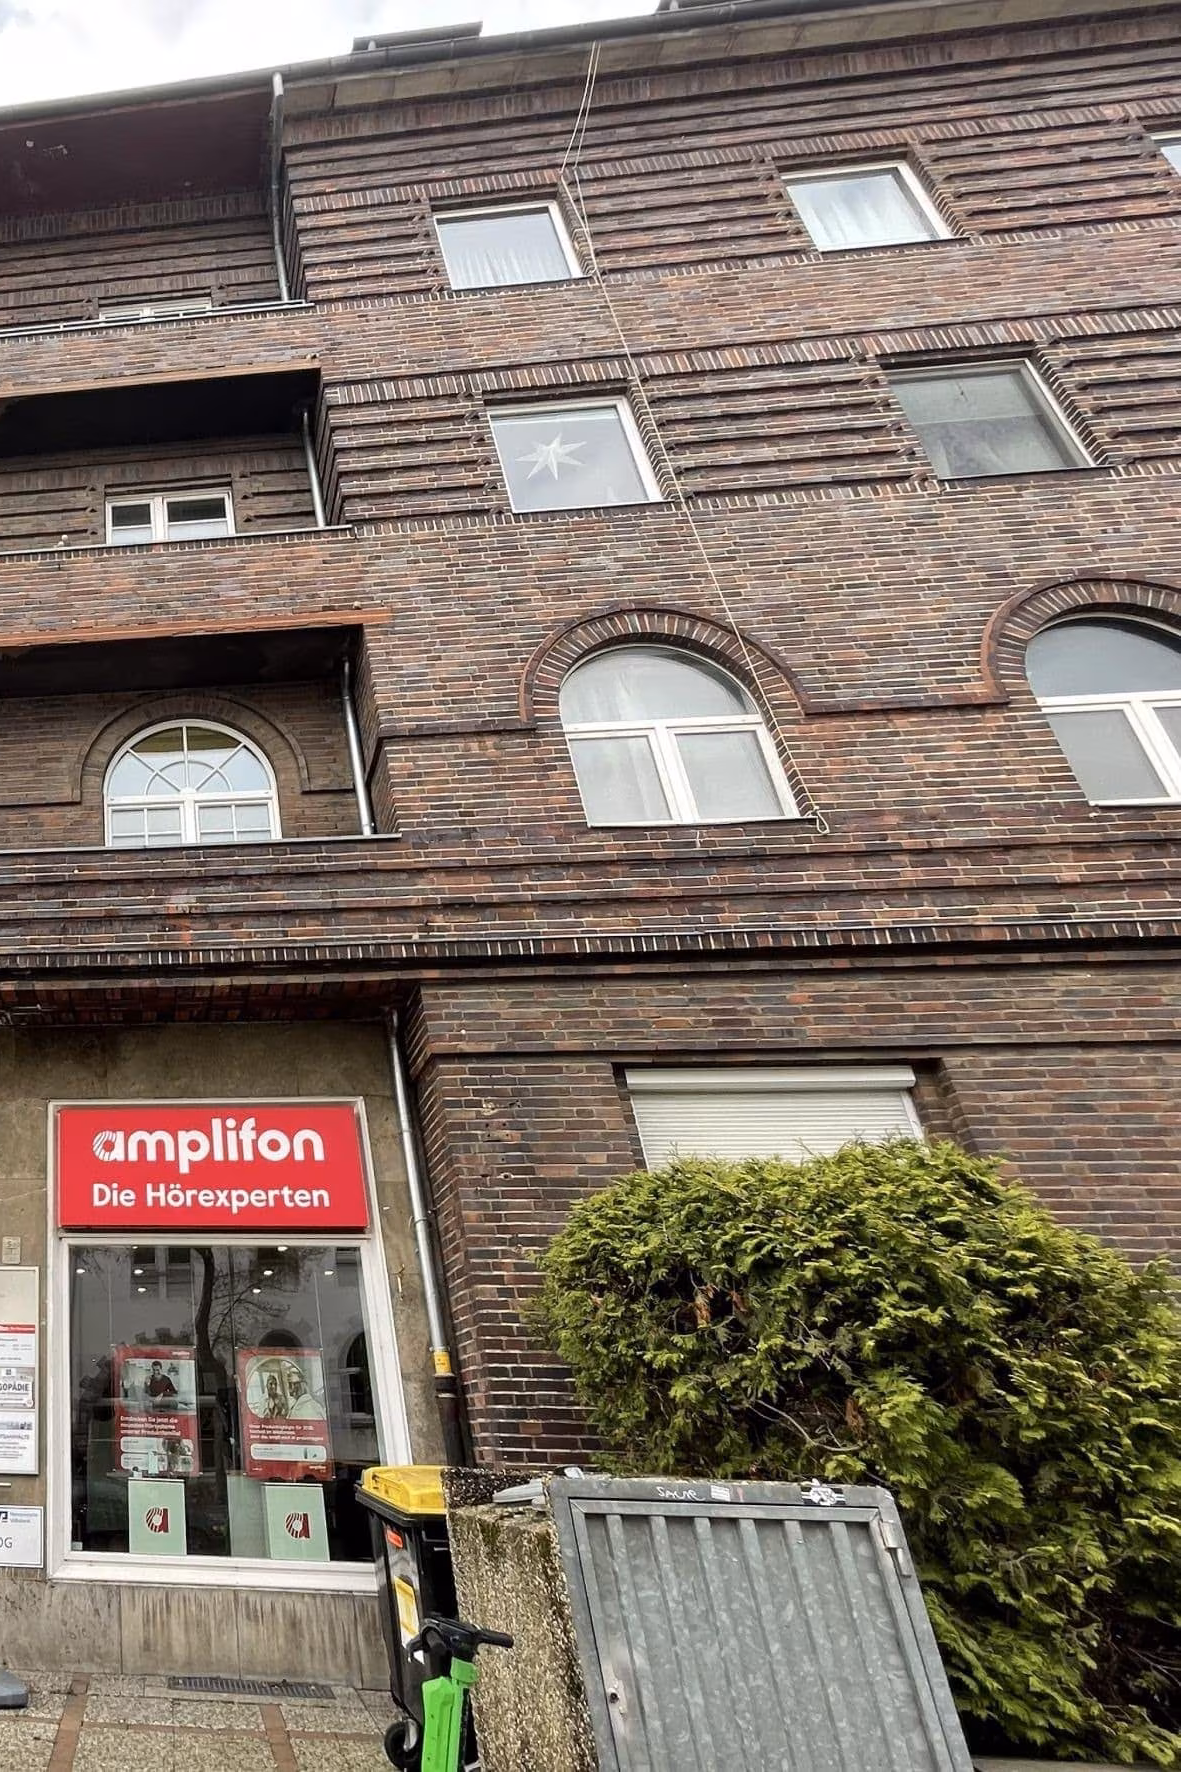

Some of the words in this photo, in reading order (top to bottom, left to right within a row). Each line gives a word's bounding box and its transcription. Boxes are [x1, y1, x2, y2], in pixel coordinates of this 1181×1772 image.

[92, 1117, 325, 1174] amplifon
[92, 1183, 136, 1208] Die
[146, 1183, 330, 1214] Hörexperten
